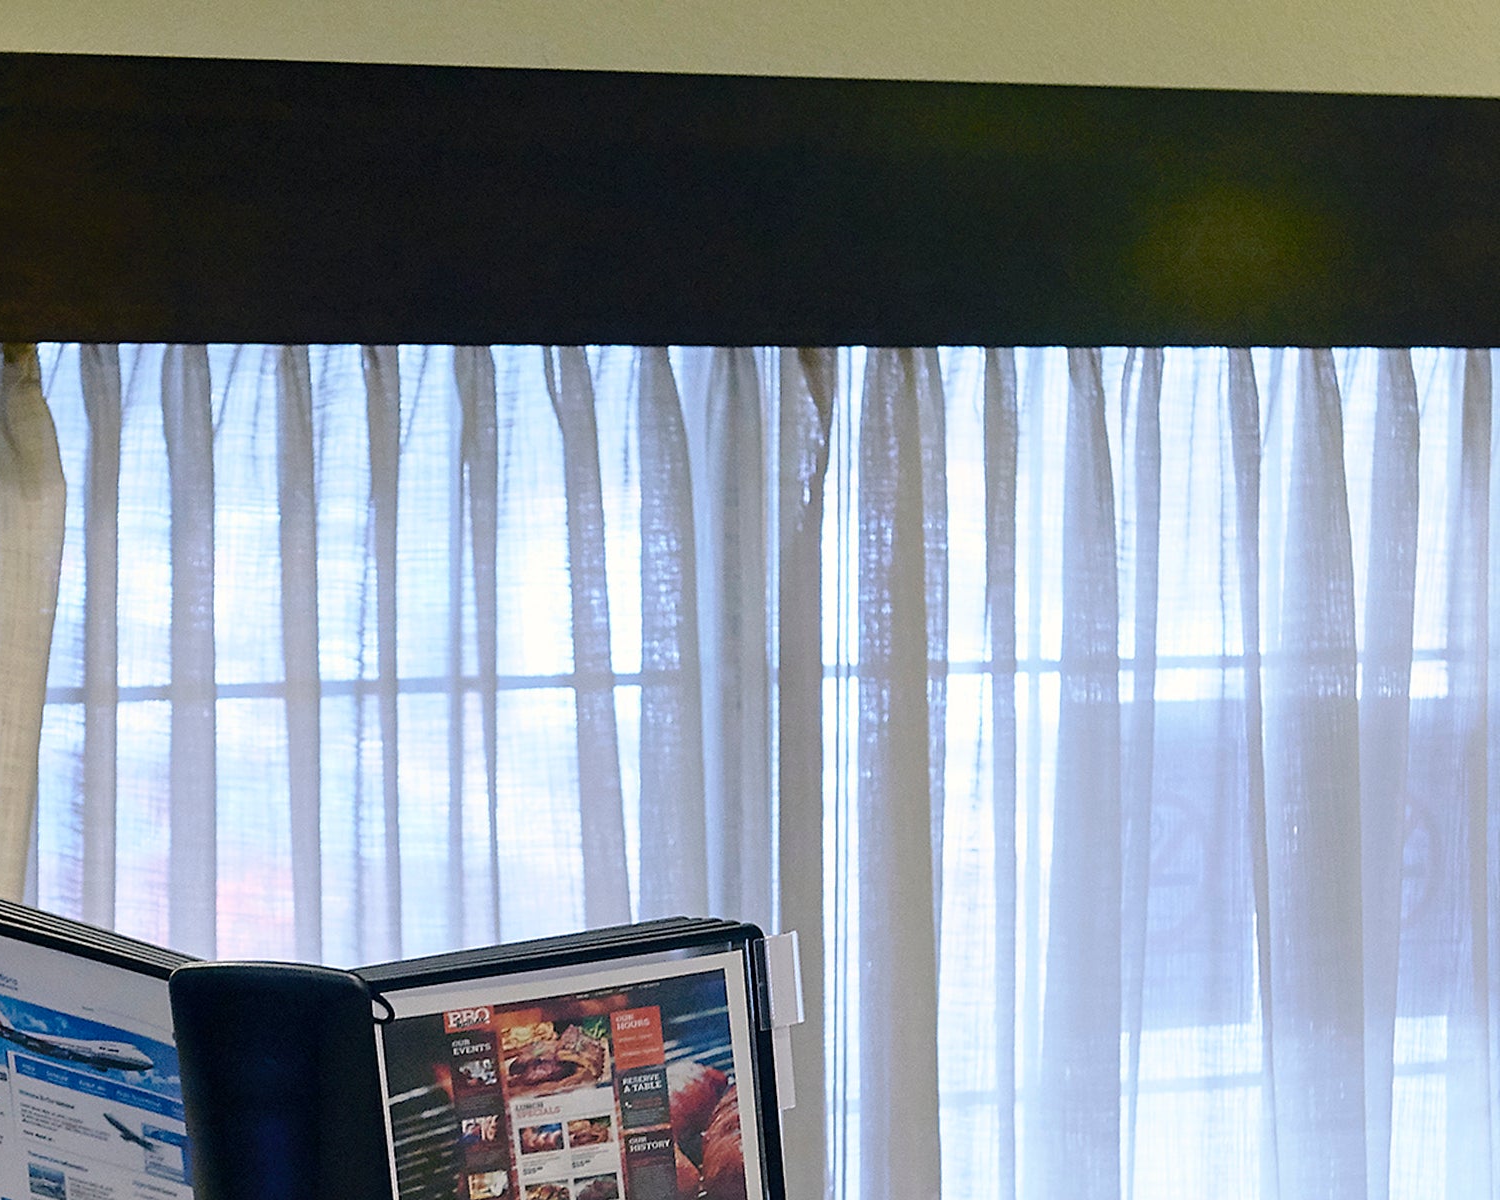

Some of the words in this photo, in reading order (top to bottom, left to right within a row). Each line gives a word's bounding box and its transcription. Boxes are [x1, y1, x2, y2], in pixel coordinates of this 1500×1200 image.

[616, 1018, 650, 1031] HOURS
[453, 1042, 492, 1056] EVENTS
[622, 1073, 659, 1085] RESERVE
[623, 1085, 631, 1093] A
[631, 1080, 662, 1092] TABLE
[516, 1106, 561, 1118] SPECIALS
[630, 1139, 670, 1153] HISTORY
